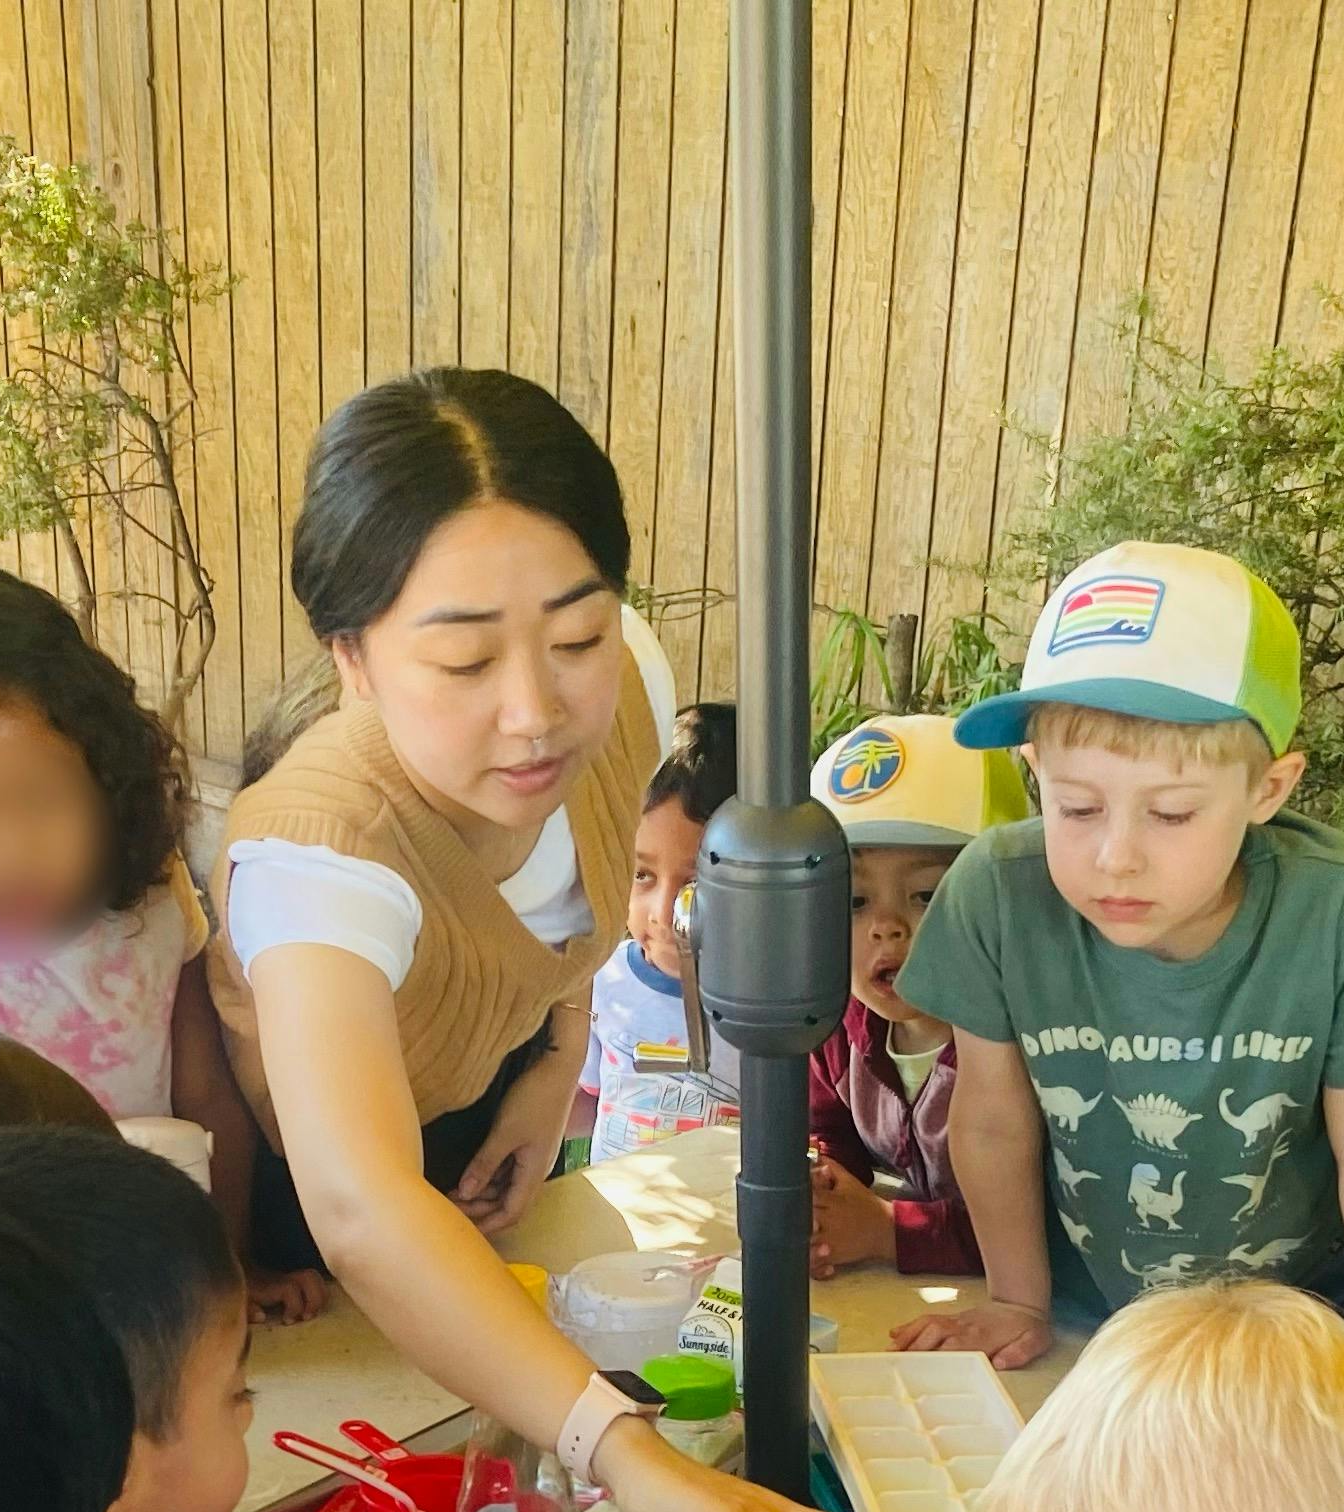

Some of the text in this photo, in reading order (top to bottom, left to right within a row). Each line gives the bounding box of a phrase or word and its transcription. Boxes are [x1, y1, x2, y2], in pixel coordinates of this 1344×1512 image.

[1021, 1026, 1204, 1062] DINOAURS
[1211, 1035, 1223, 1062] I
[697, 1300, 729, 1315] HALF
[728, 1310, 738, 1319] &
[679, 1336, 730, 1353] Sunnyside
